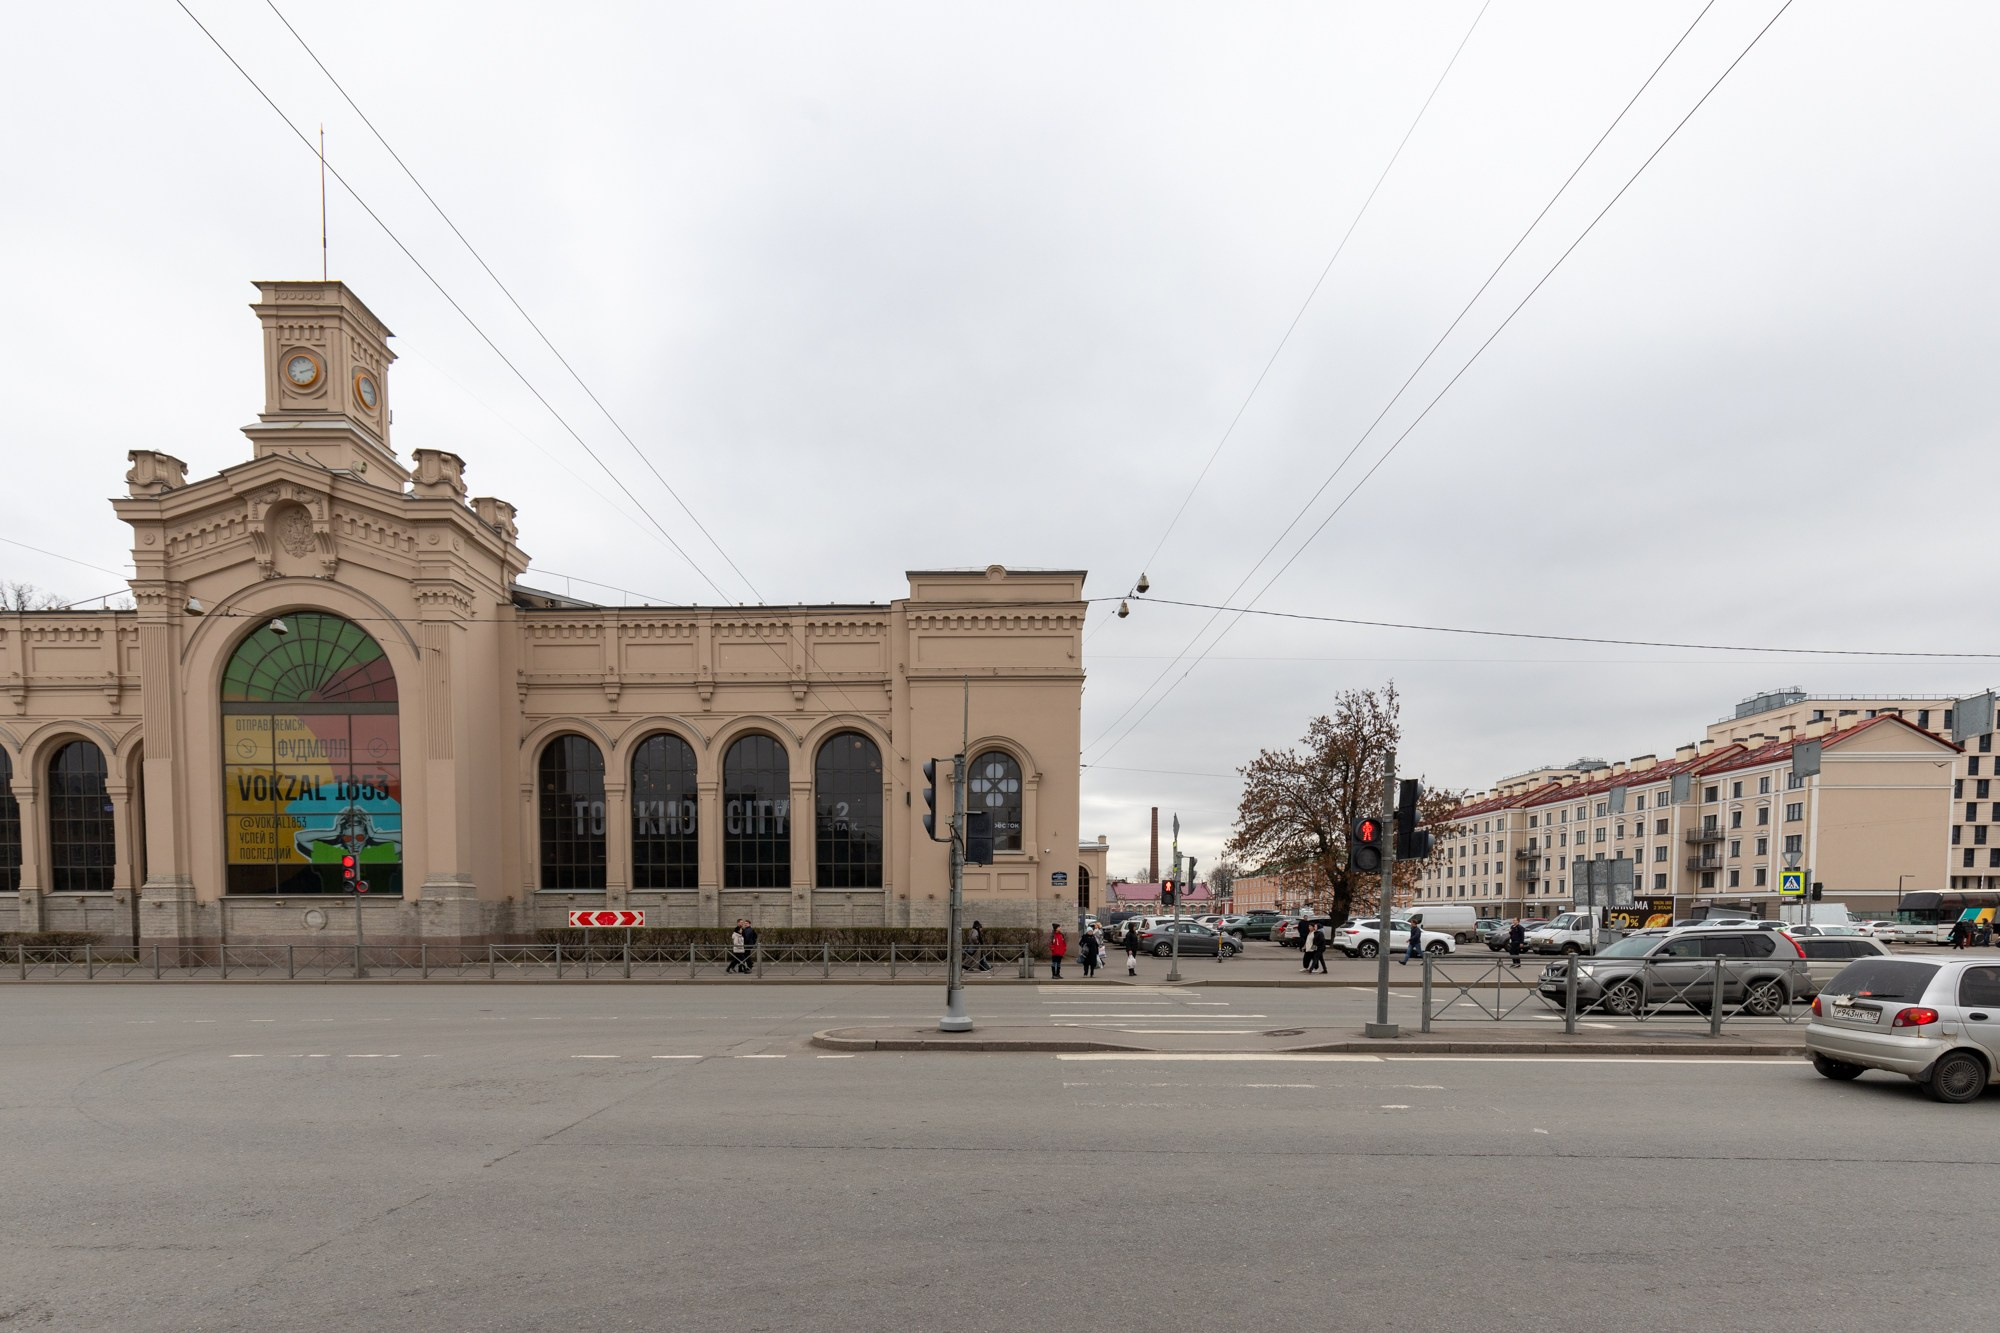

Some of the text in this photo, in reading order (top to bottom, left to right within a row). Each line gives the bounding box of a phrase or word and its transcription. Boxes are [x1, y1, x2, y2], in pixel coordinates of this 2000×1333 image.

[278, 738, 347, 762] ФУДМОЛЛ
[237, 774, 389, 801] VOKZAL 1853
[727, 799, 790, 835] CITY
[836, 801, 849, 821] 2
[240, 816, 307, 830] @VOKZAL1853
[239, 830, 275, 844] УСПЕЙ В
[239, 845, 292, 862] ПОСЛЕДНИЙ
